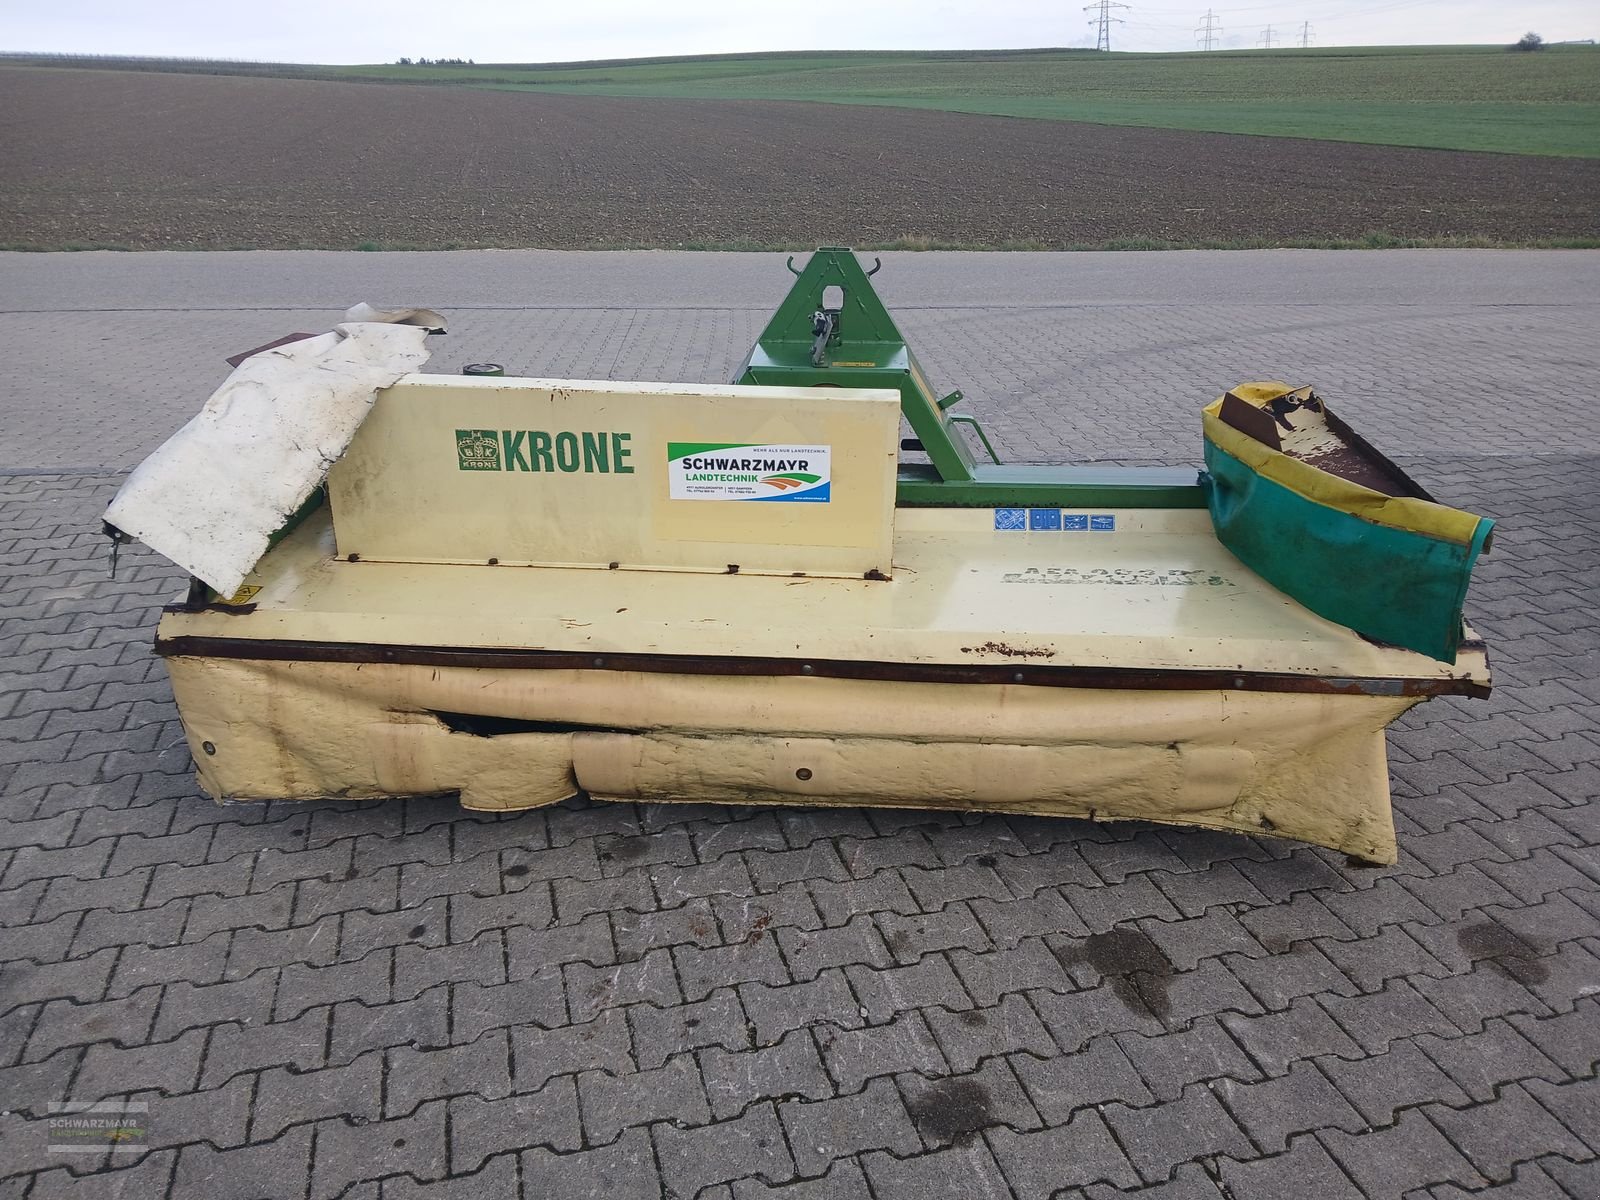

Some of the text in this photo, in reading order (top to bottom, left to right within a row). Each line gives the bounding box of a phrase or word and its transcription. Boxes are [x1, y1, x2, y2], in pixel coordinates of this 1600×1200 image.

[502, 430, 635, 473] KRONE
[463, 460, 497, 468] KRONE
[682, 457, 809, 471] SCHWARZMAYR
[685, 473, 759, 483] LANDTECHNIK
